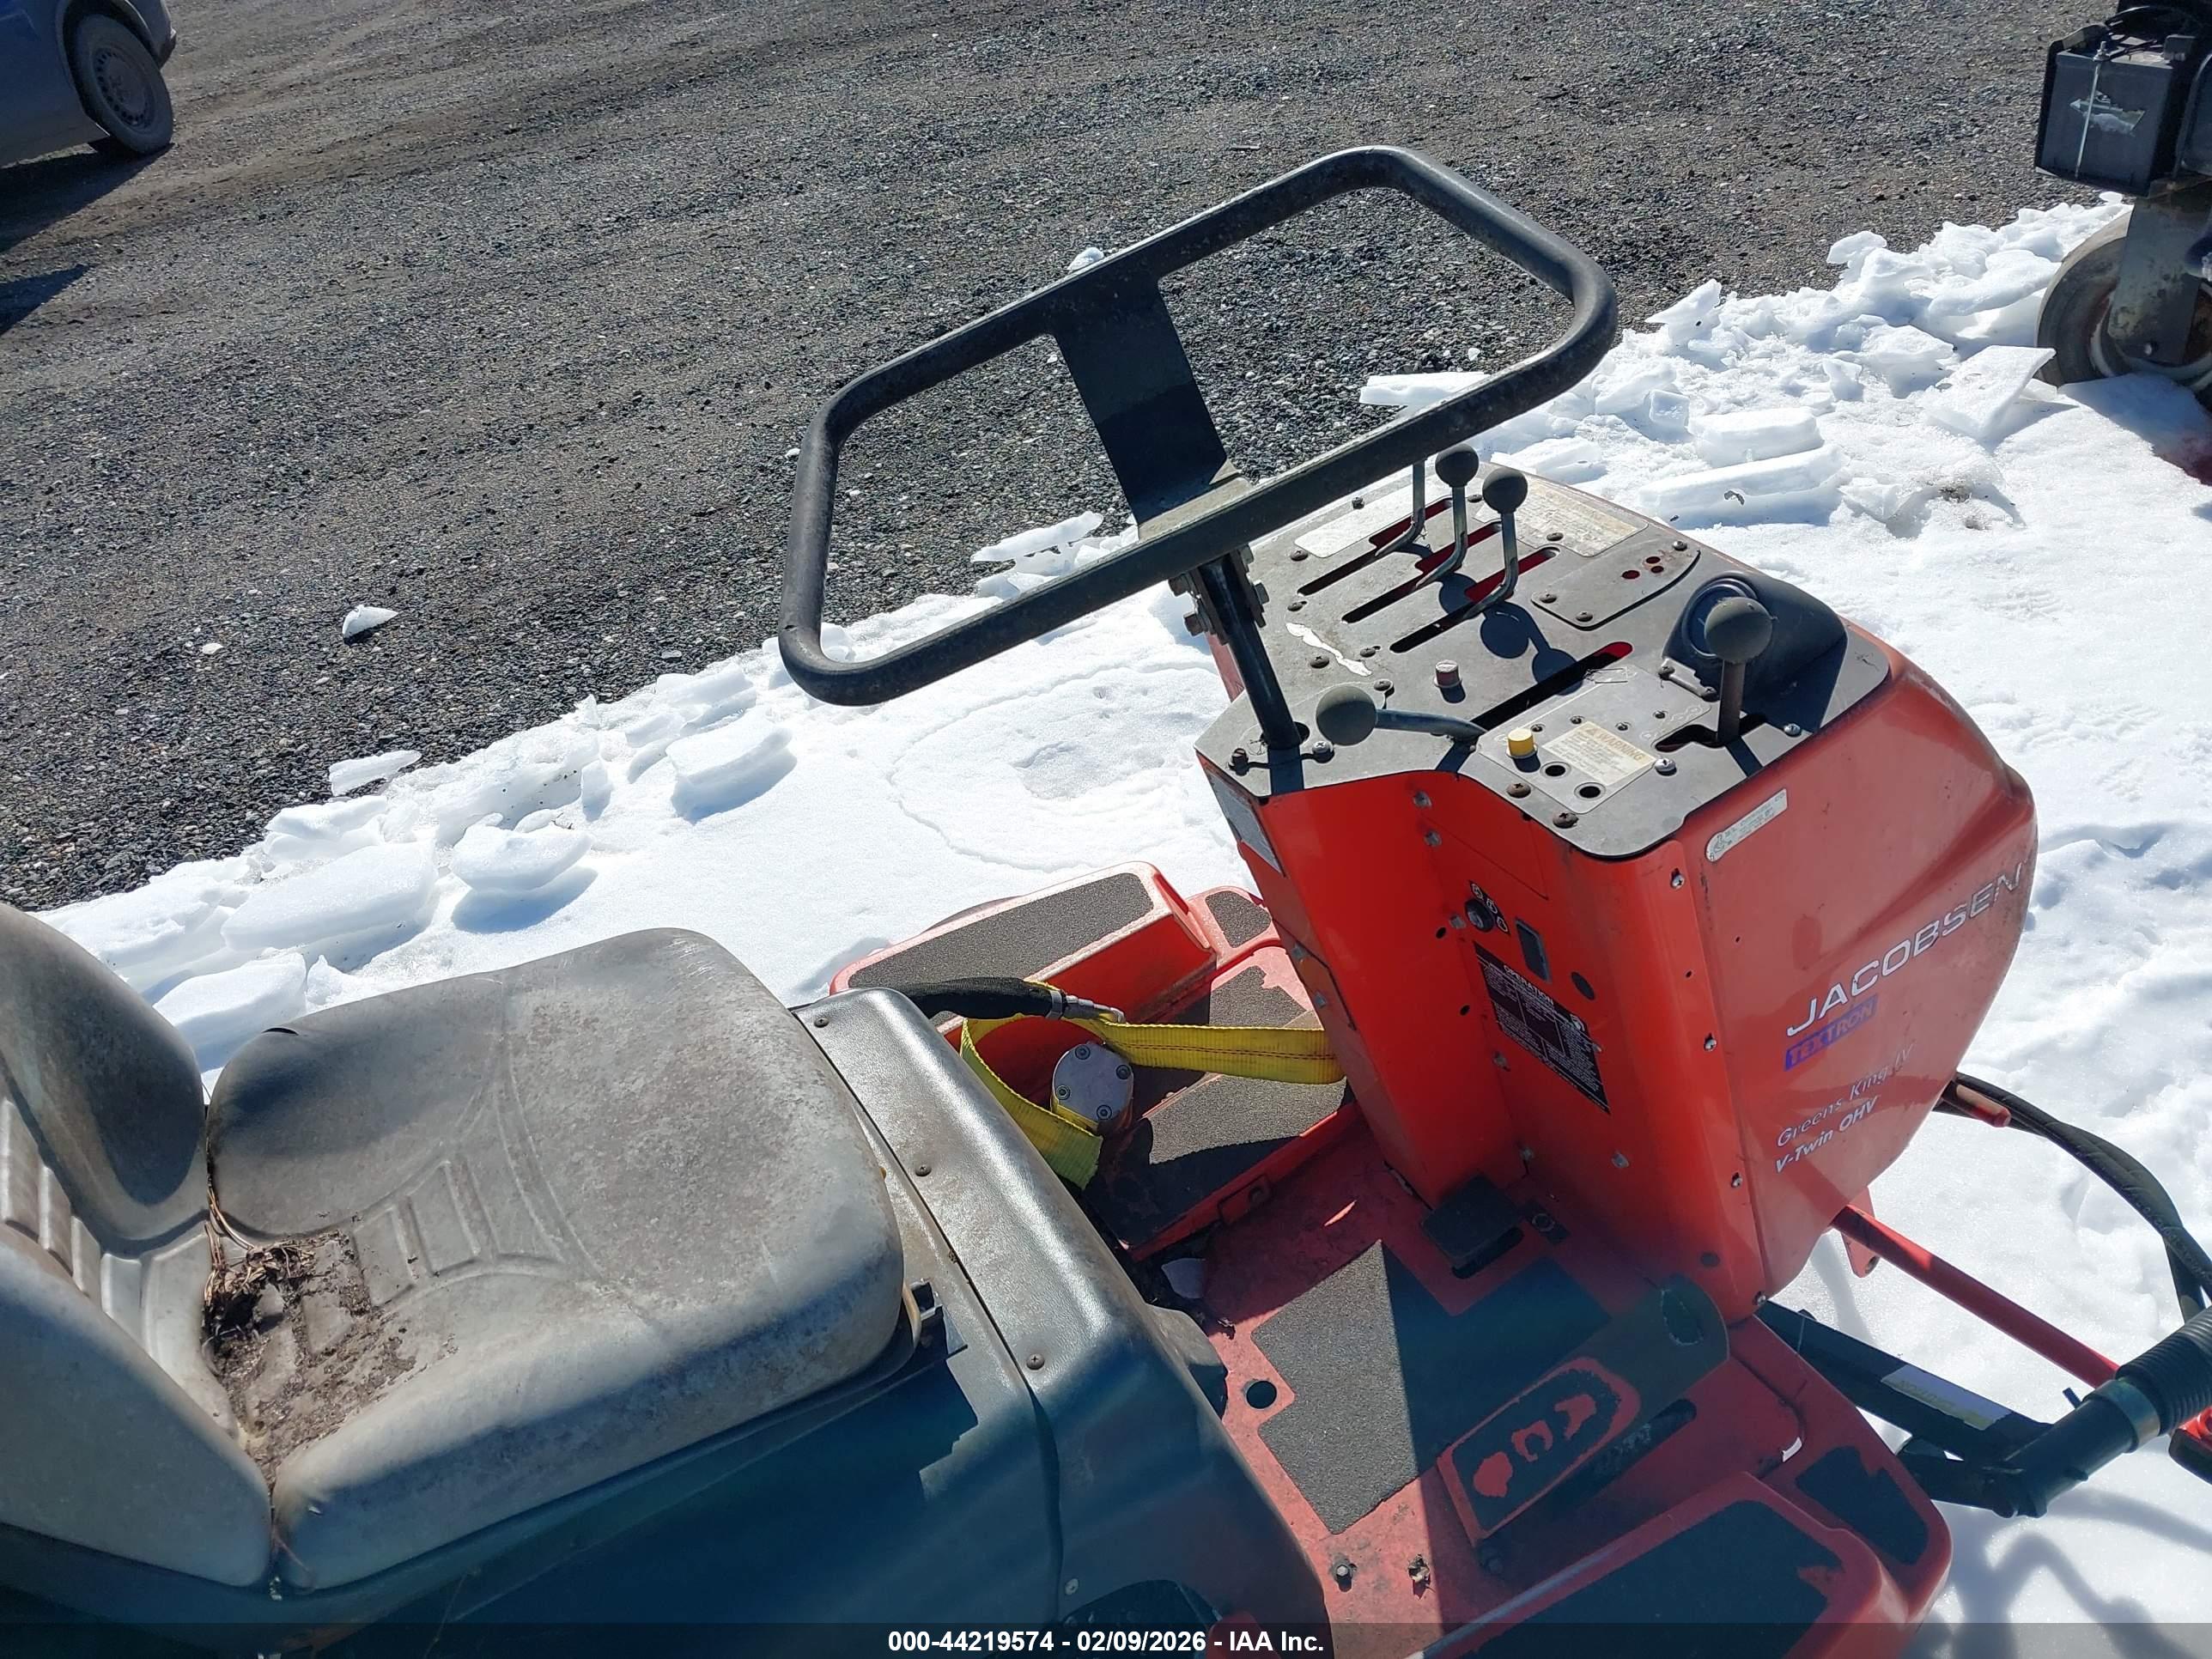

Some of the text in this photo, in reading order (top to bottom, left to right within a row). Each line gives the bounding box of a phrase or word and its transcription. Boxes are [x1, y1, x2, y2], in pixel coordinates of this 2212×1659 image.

[1597, 732, 1644, 761] WARNING
[1786, 861, 2025, 1036] JACOBSEN
[1787, 1000, 1875, 1068] TEXTRON
[1776, 1095, 1879, 1173] V-Twin OHV
[1778, 1097, 1843, 1147] Greens
[1850, 1066, 1888, 1101] King
